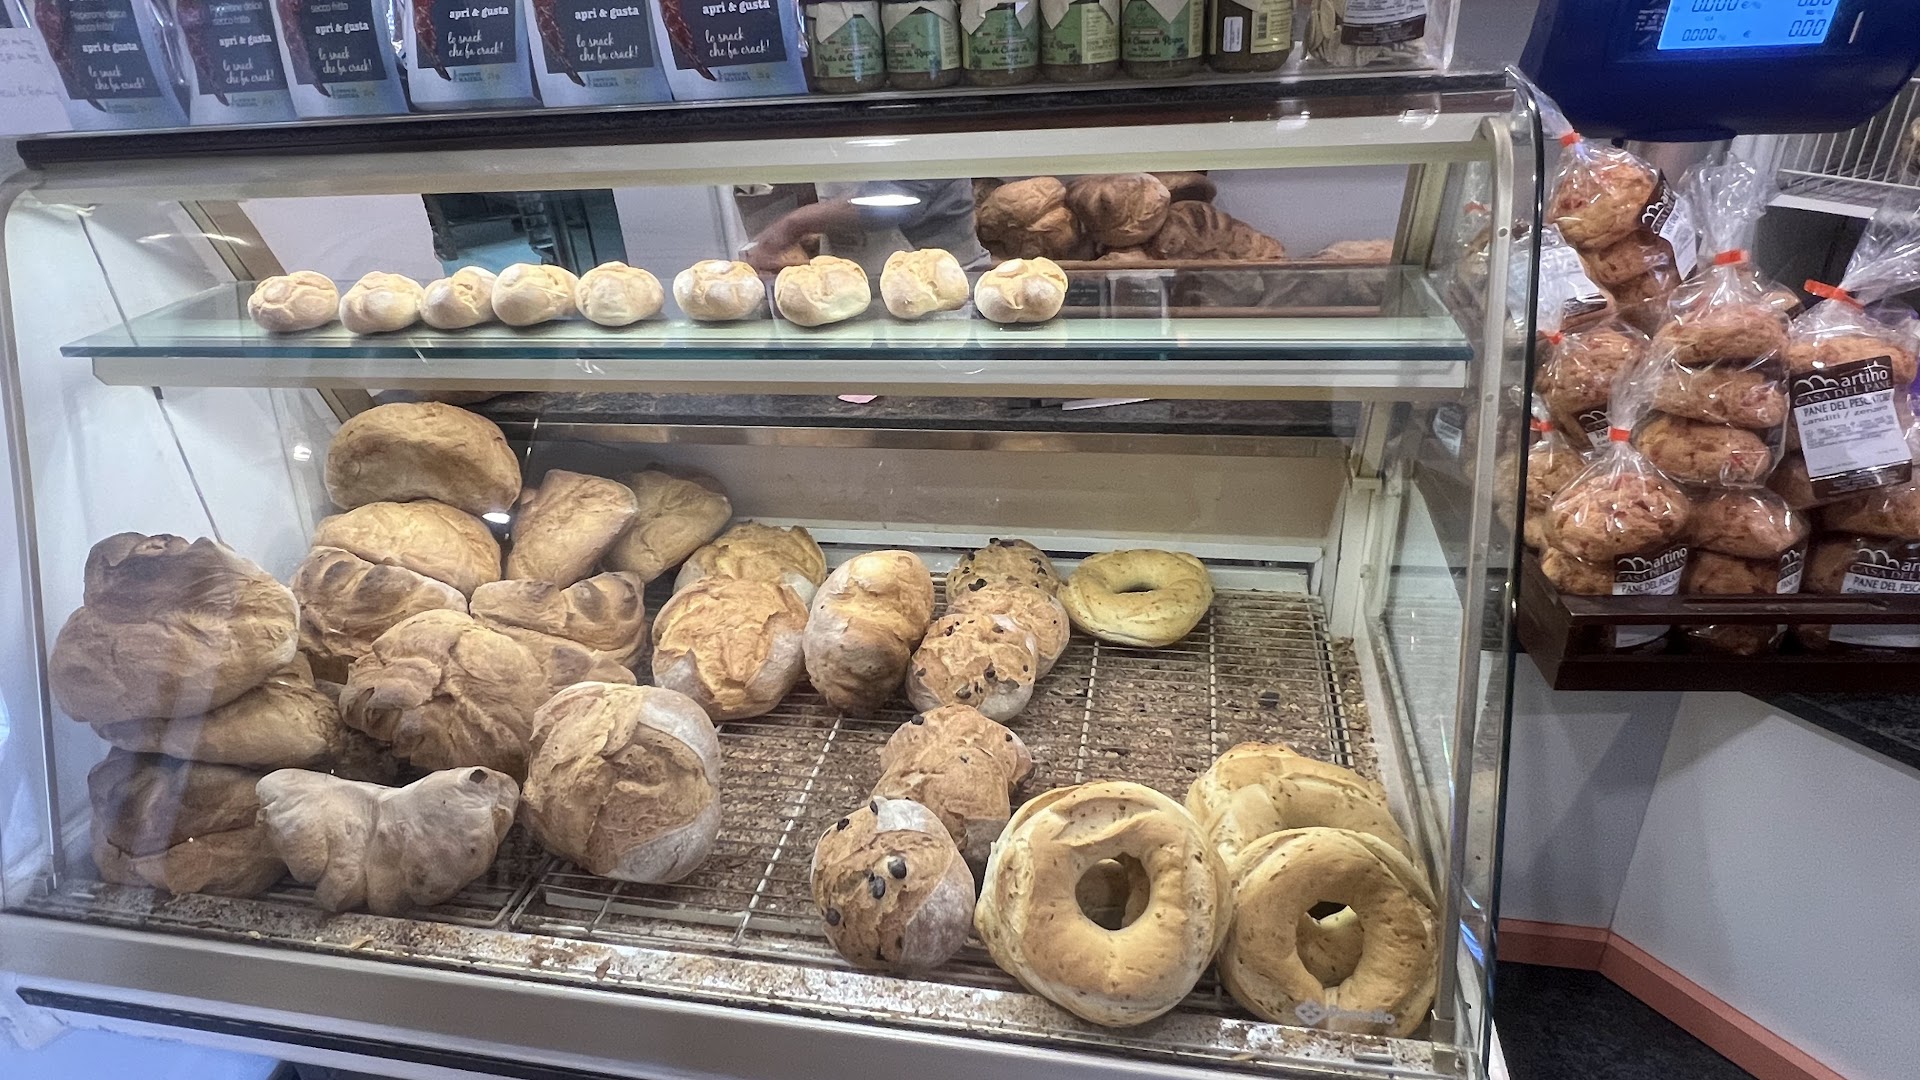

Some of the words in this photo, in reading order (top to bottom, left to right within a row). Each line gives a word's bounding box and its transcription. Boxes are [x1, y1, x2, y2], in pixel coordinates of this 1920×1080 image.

[449, 8, 470, 20] apri
[471, 8, 480, 17] &
[481, 6, 509, 18] gusta
[574, 8, 598, 22] apri
[599, 8, 608, 18] &
[609, 6, 640, 20] gusta
[702, 1, 726, 16] apri
[728, 2, 738, 12] &
[739, 0, 770, 14] gusta
[315, 22, 334, 36] apri
[335, 23, 342, 32] &
[344, 20, 370, 34] gusta
[718, 26, 744, 42] snack
[219, 35, 238, 48] apri
[239, 36, 246, 44] &
[247, 34, 272, 46] gusta
[458, 29, 482, 44] snack
[588, 32, 614, 47] snack
[82, 42, 102, 54] apri
[103, 43, 111, 52] &
[112, 42, 138, 53] gusta
[328, 46, 350, 60] snack
[448, 43, 464, 57] che
[476, 41, 504, 56] crack!
[580, 46, 596, 62] che
[609, 44, 638, 60] crack!
[709, 42, 726, 58] che
[740, 38, 770, 54] crack!
[1795, 390, 1830, 406] CASA
[1835, 386, 1858, 398] DEL
[1864, 380, 1892, 392] PANE
[1803, 404, 1828, 417] PANE
[1830, 400, 1848, 412] DEL
[1649, 568, 1665, 578] DEL
[1668, 559, 1686, 570] PAN
[1849, 564, 1888, 578] CASA
[1891, 570, 1917, 580] DEL
[1621, 583, 1643, 593] PANE
[1645, 580, 1658, 591] DEL
[1853, 576, 1879, 588] PANE
[1880, 581, 1897, 590] DEL
